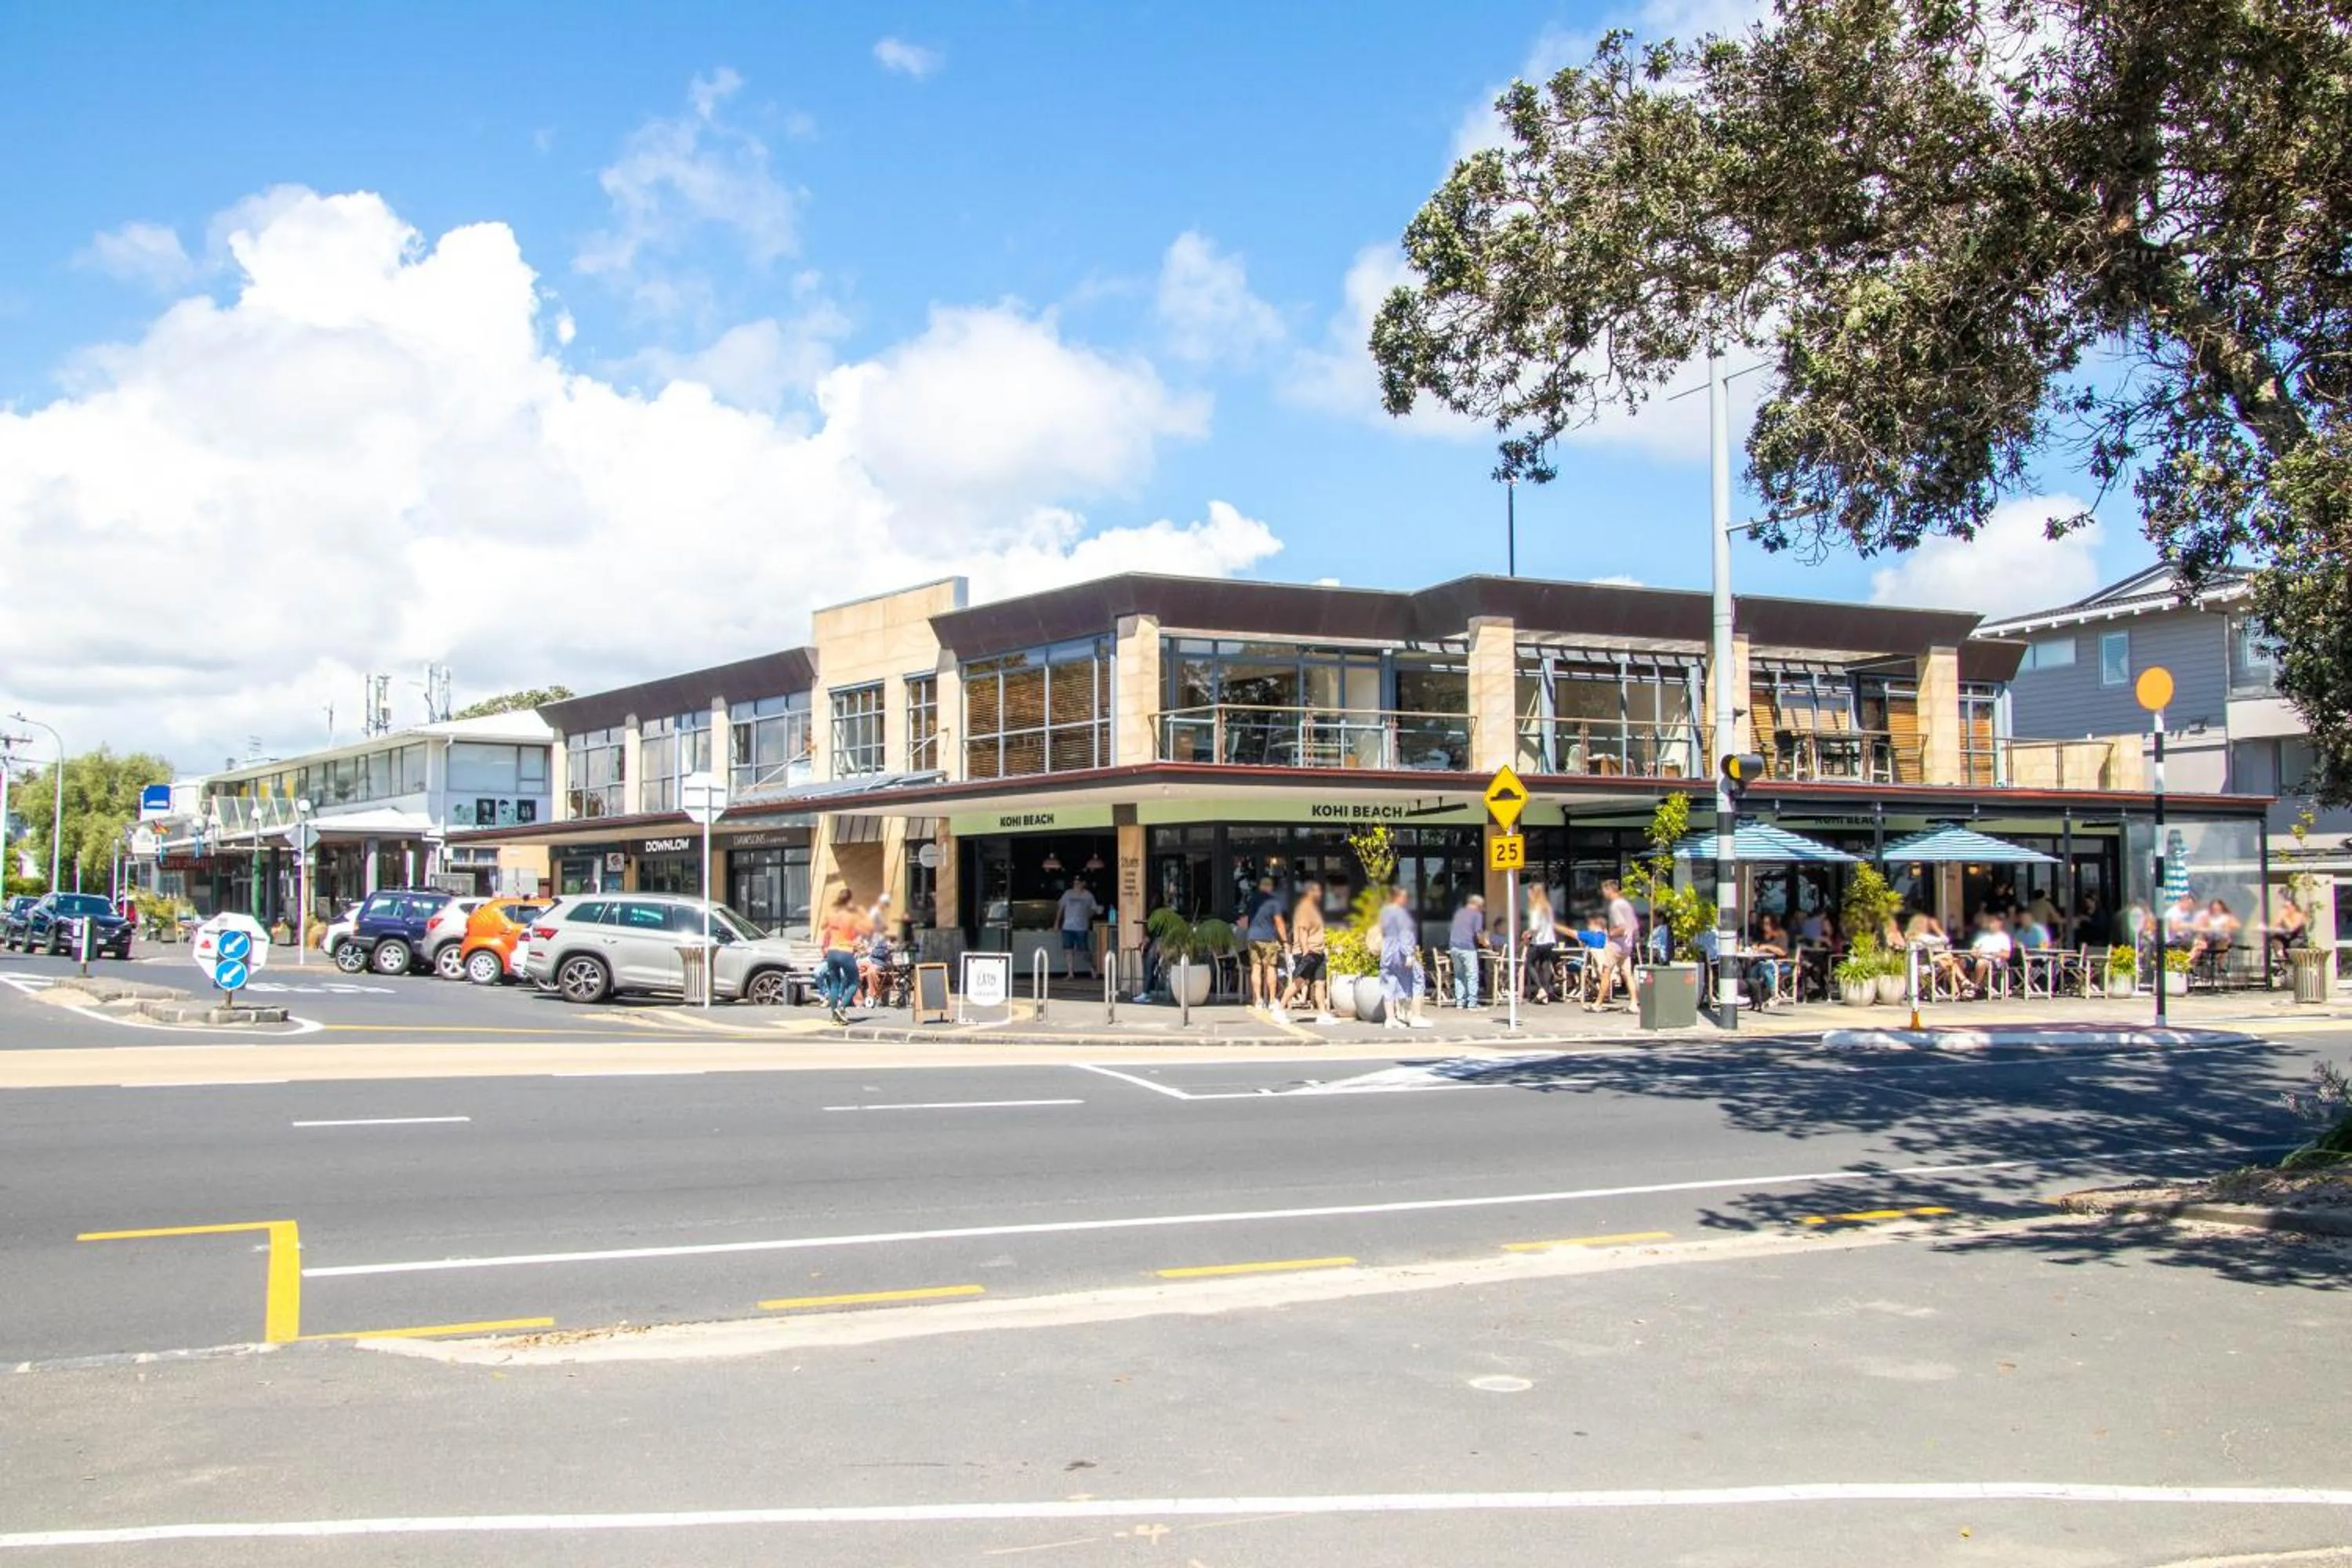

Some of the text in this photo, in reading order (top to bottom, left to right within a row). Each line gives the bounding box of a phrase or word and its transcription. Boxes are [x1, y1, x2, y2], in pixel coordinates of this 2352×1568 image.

[1312, 805, 1402, 818] KOHI BEACH
[1000, 813, 1054, 827] KOHI BEACH
[645, 838, 690, 852] DOWNLOW
[1497, 844, 1518, 861] 25
